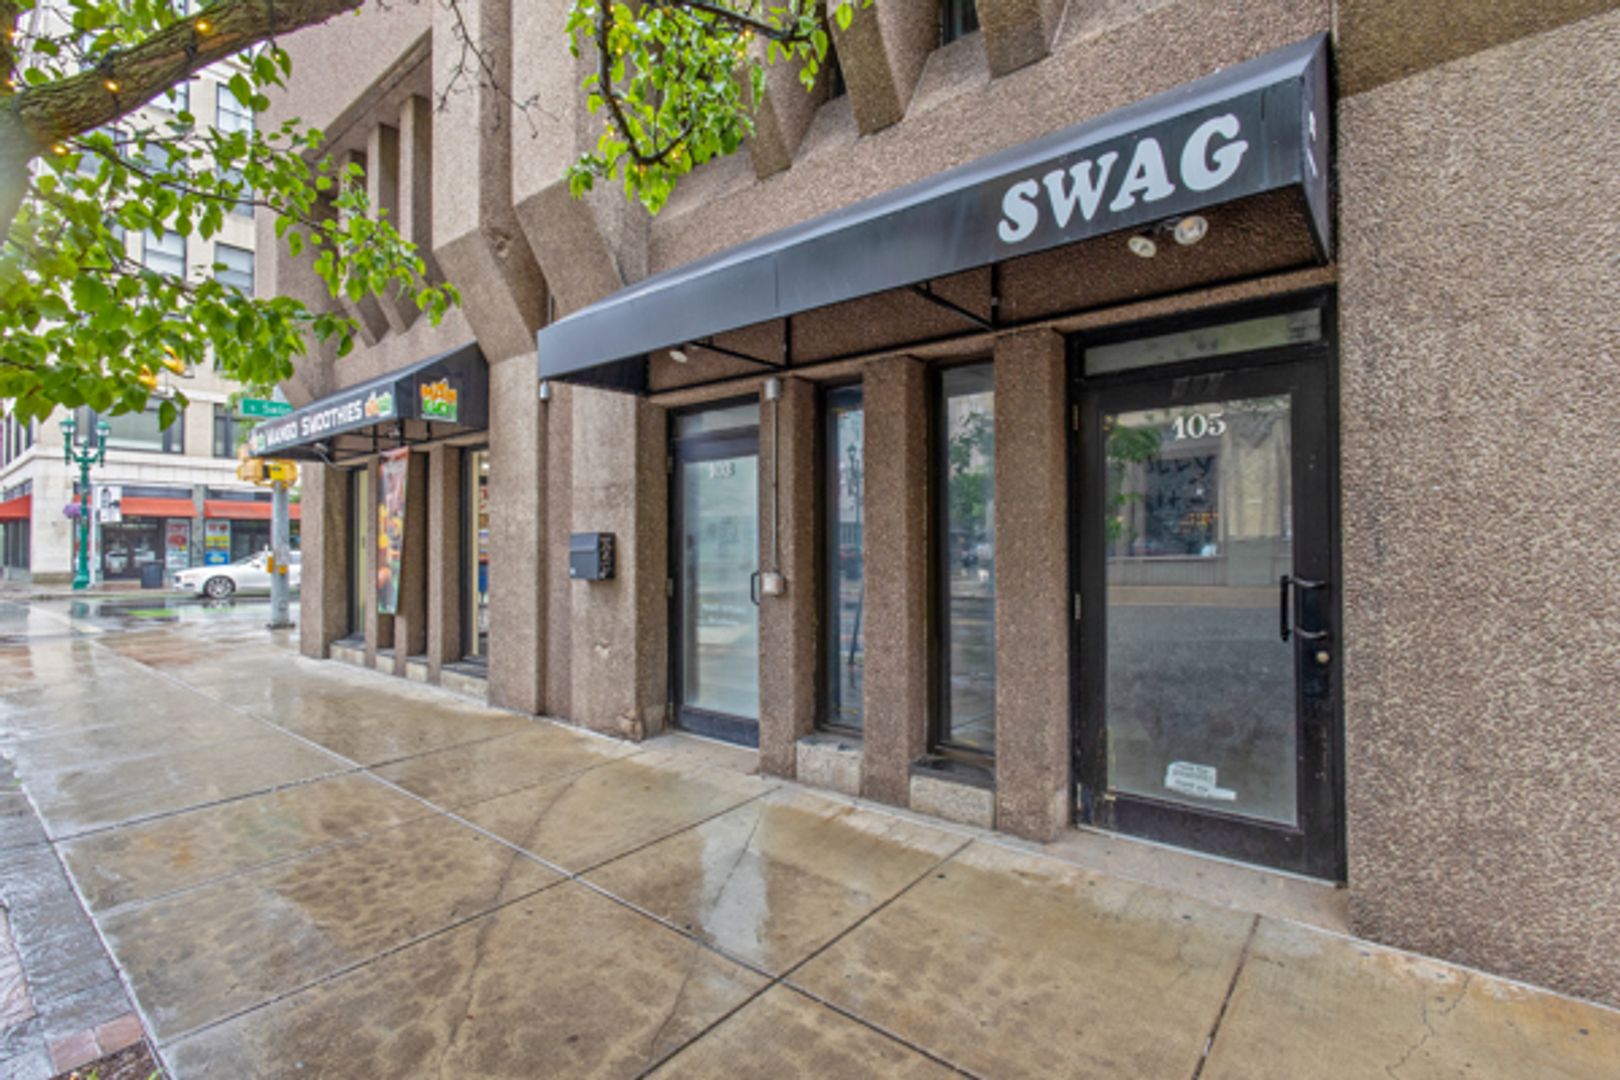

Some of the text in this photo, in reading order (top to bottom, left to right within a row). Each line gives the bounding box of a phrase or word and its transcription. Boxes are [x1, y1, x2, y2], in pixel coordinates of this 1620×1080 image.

[998, 113, 1249, 243] SWAG
[301, 400, 363, 437] SMOOTHIES
[1171, 411, 1227, 440] 105
